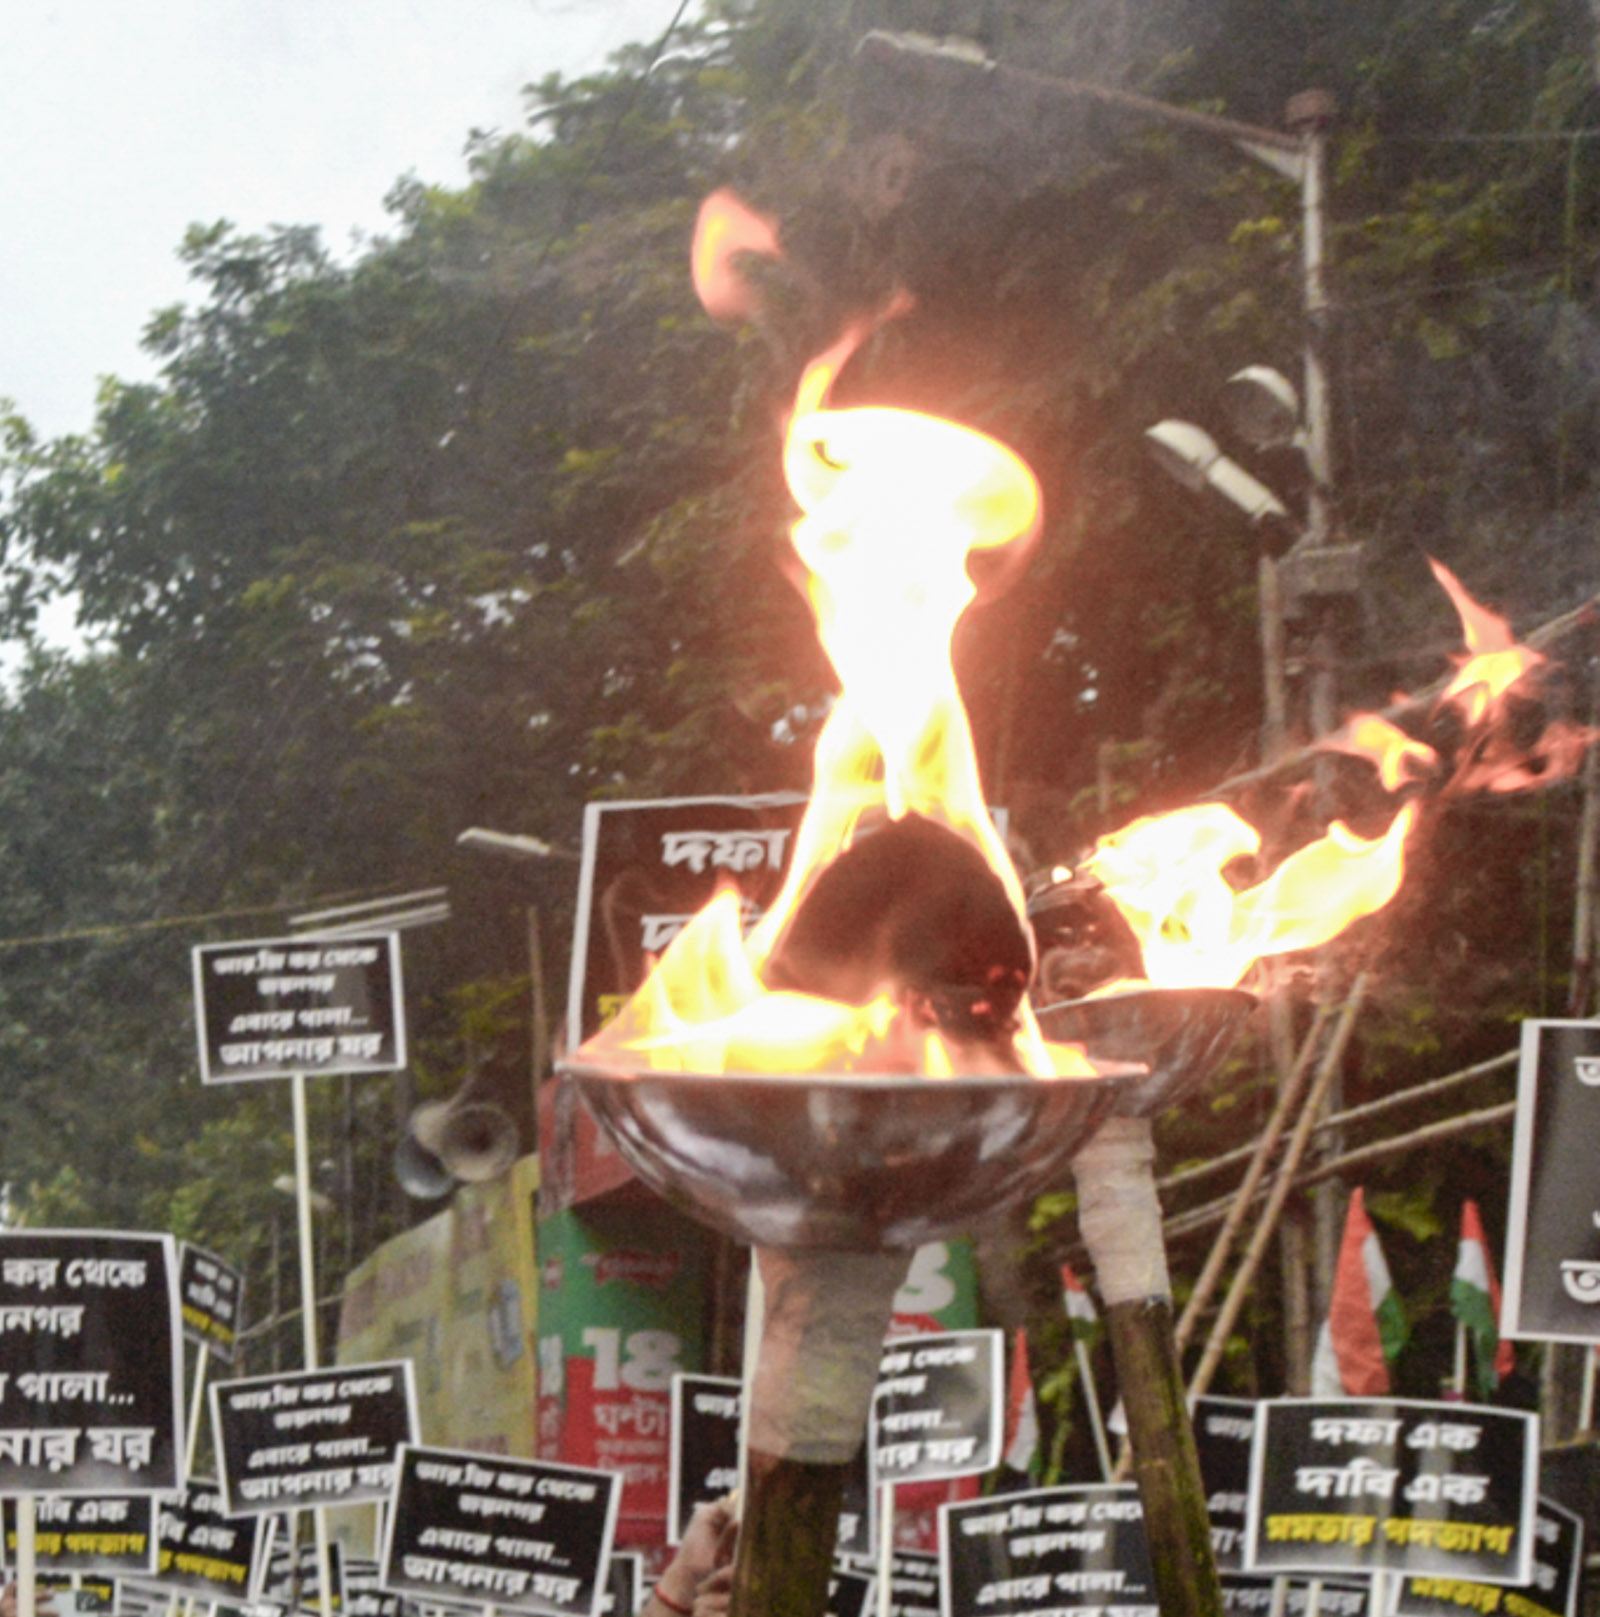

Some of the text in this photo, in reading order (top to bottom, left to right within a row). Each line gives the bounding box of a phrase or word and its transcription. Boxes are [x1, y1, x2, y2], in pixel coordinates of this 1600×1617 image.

[661, 829, 791, 874] দফা
[2, 1258, 60, 1291] কর
[65, 1258, 147, 1288] থেকে
[86, 1427, 155, 1471] ঘর
[1311, 1417, 1482, 1451] দফা এক
[1295, 1457, 1490, 1505] দাবি এক
[1265, 1513, 1377, 1547] মমতার
[1381, 1517, 1514, 1555] পদত্যাগ
[402, 1555, 581, 1604] আপনার ঘর
